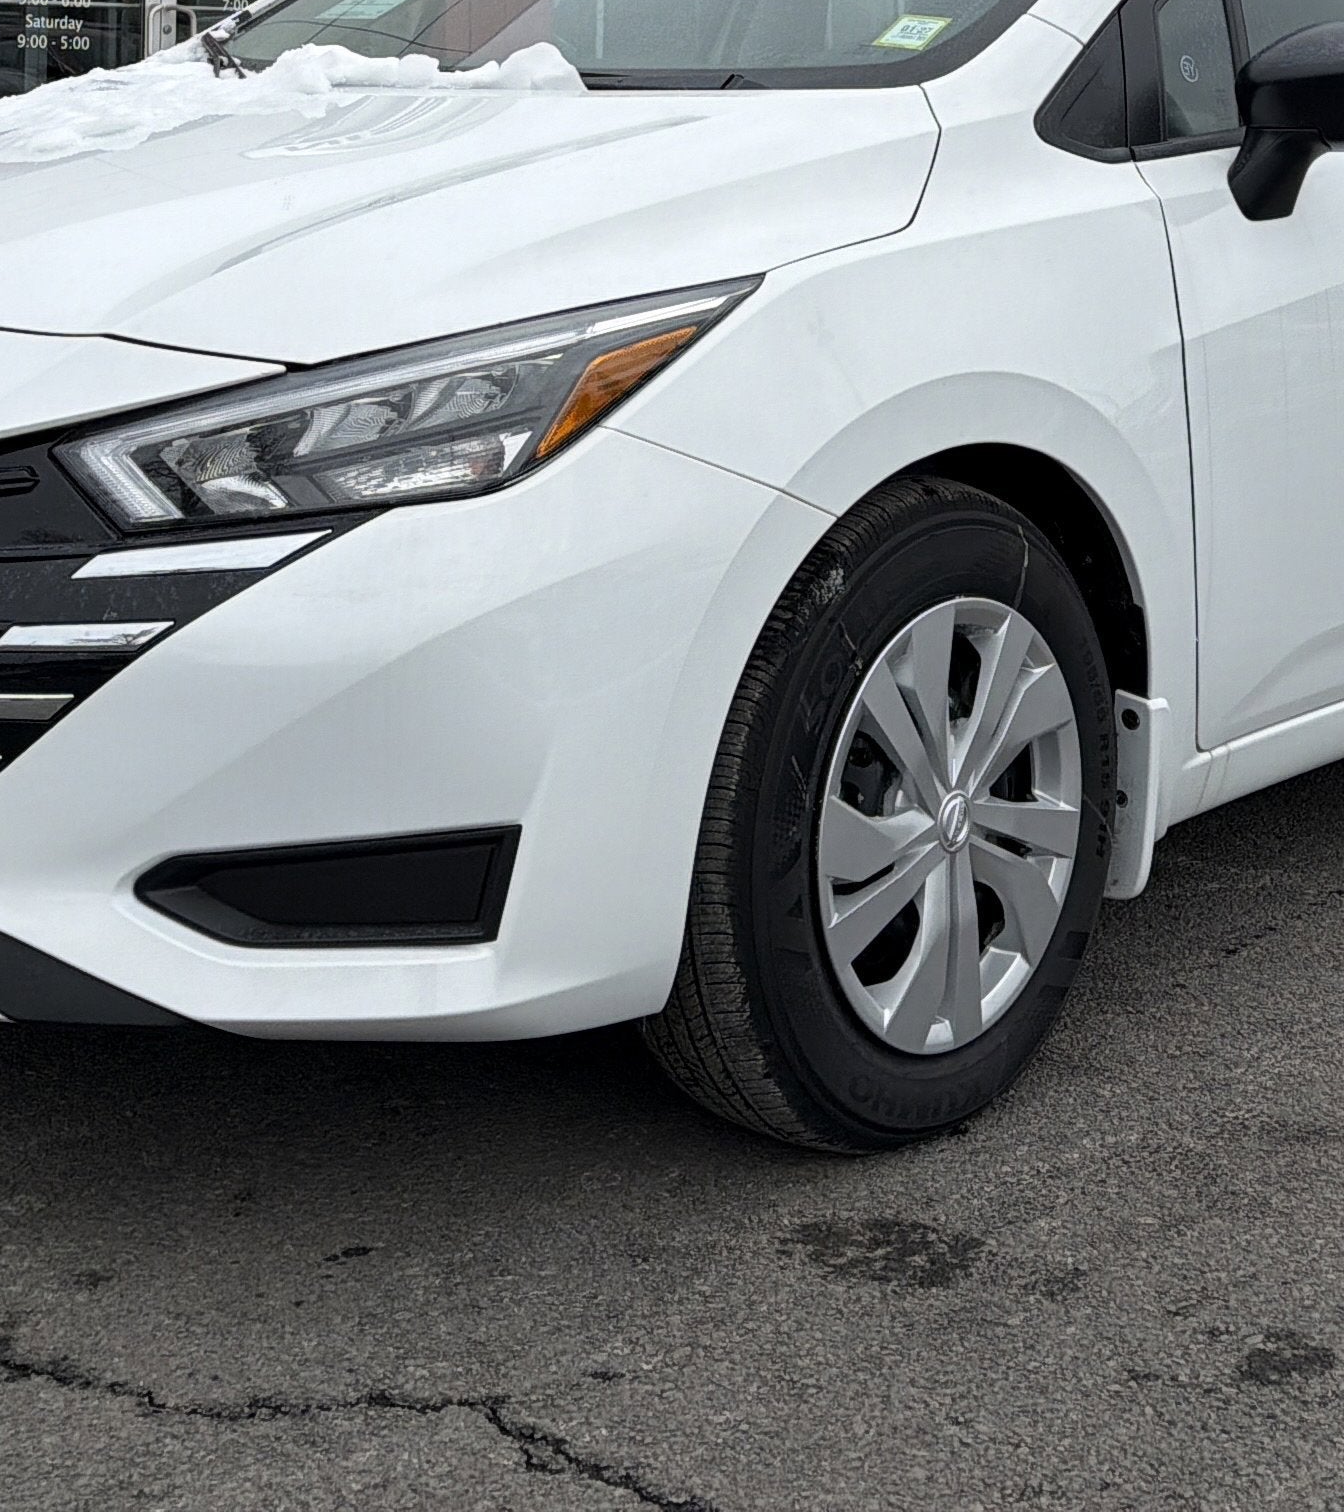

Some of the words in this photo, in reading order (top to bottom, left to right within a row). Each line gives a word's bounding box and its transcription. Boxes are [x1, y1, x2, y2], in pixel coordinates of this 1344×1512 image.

[25, 13, 84, 33] Saturday
[17, 33, 48, 49] 9:00
[60, 35, 90, 51] 5:00
